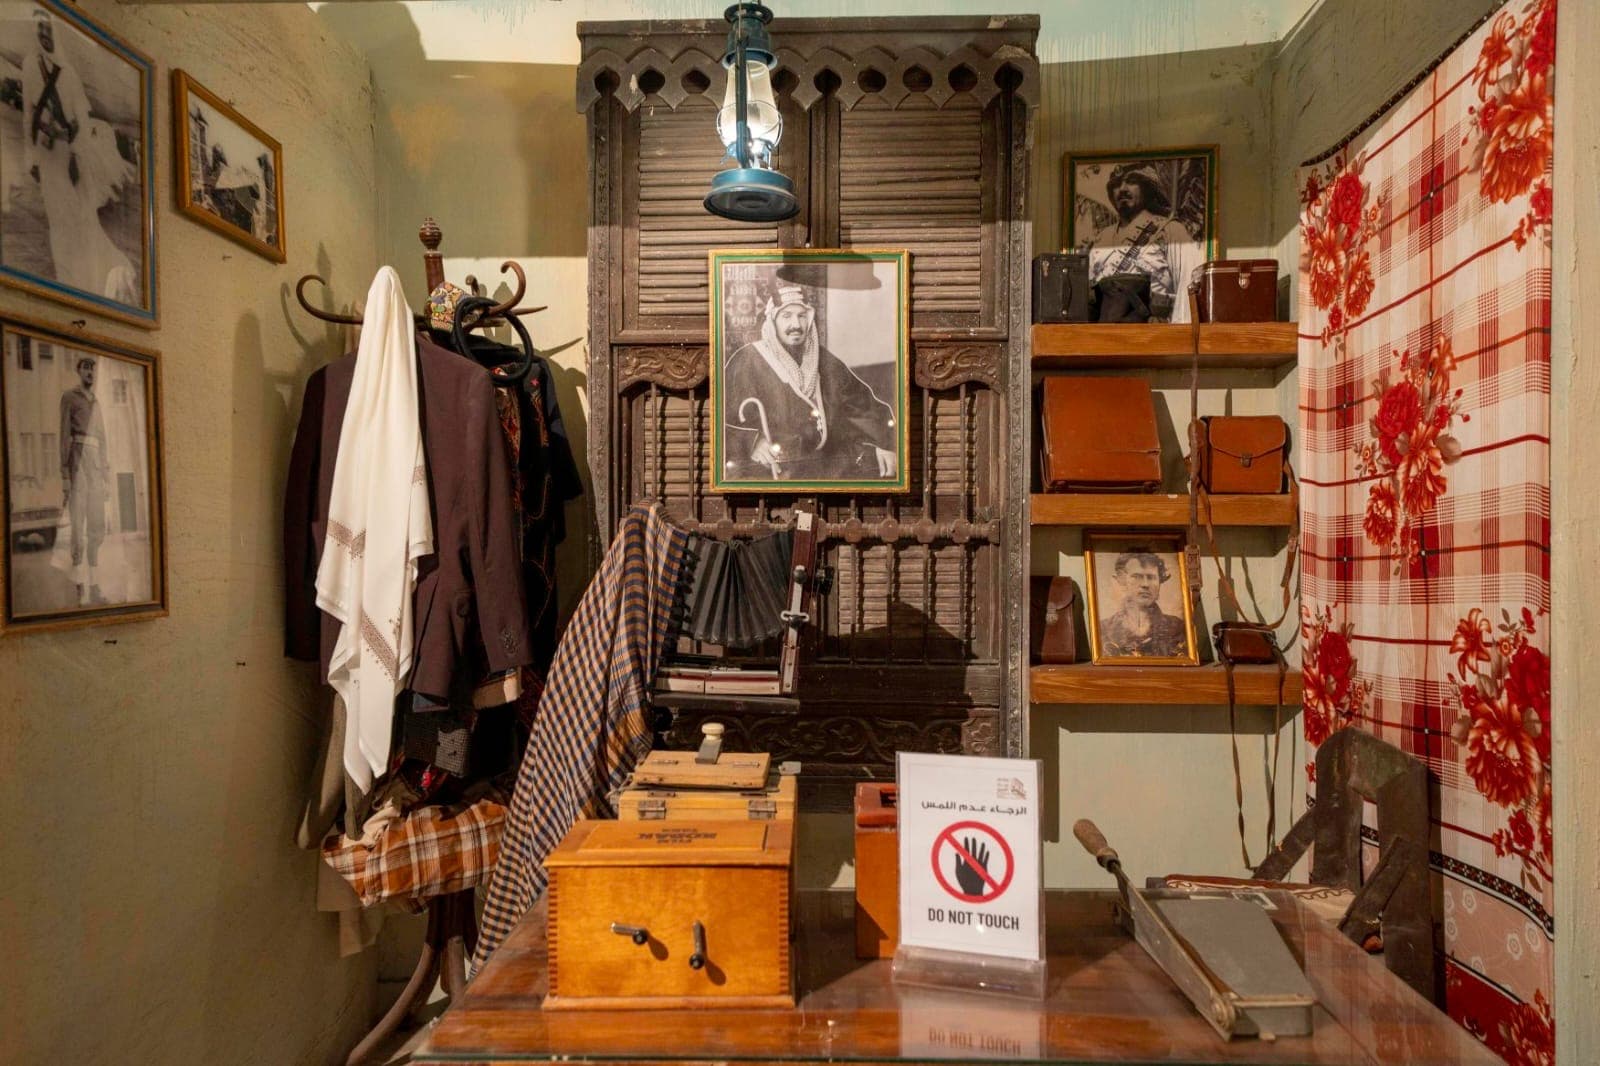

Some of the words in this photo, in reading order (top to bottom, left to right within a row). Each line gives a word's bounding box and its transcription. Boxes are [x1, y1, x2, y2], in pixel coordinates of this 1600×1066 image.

[921, 800, 956, 810] اللمس
[959, 803, 986, 813] عدم
[990, 805, 1027, 815] الرجاء
[928, 907, 944, 922] DO
[948, 909, 973, 926] NOT
[977, 912, 1020, 930] TOUCH
